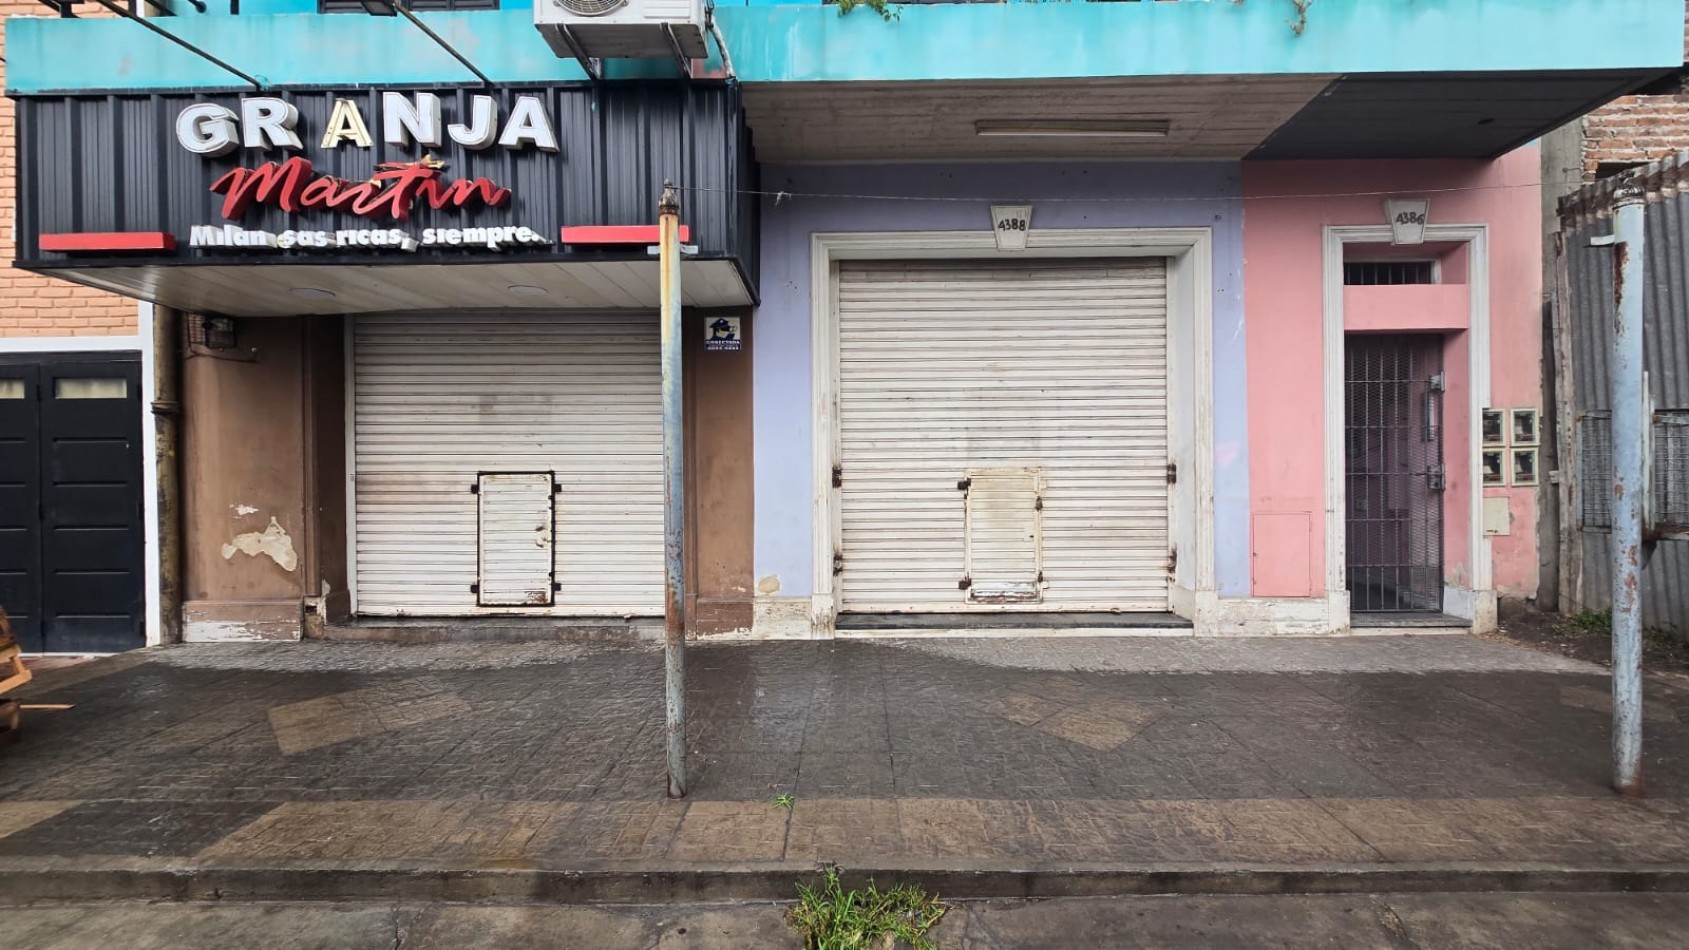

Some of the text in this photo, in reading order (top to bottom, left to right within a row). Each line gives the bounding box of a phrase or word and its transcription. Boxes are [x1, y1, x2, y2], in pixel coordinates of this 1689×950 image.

[177, 92, 558, 156] GRANJA
[209, 154, 512, 219] Martin
[998, 218, 1026, 231] 4388
[1395, 211, 1425, 225] 4386
[336, 229, 412, 251] ricas,
[422, 226, 541, 250] siempre.
